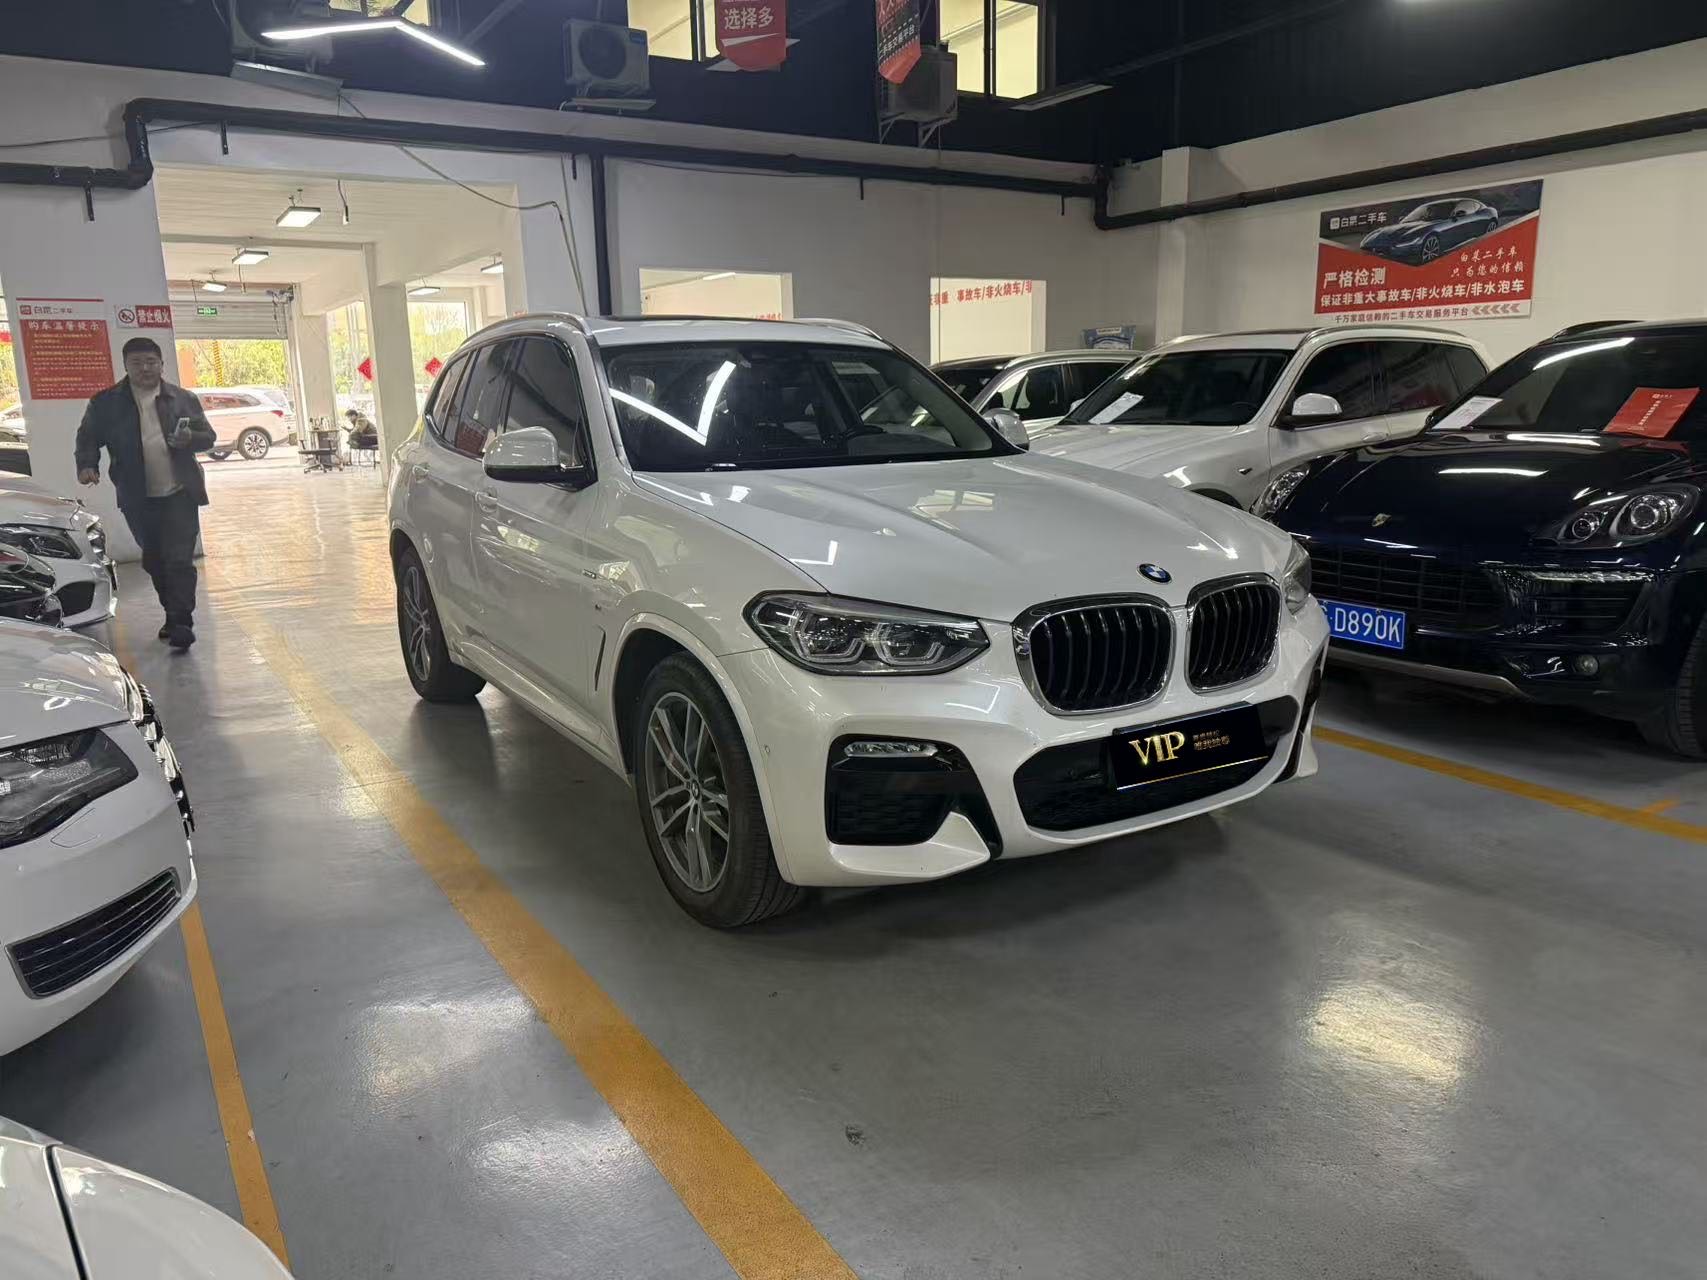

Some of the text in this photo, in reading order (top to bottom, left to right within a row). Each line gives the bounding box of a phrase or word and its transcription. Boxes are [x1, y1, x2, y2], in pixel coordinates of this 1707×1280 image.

[724, 6, 774, 30] 选择多
[1323, 266, 1387, 289] 严格检测
[1321, 278, 1525, 307] 保证非重大事故车/非火烧车/非水泡车
[1128, 731, 1185, 765] VIP
